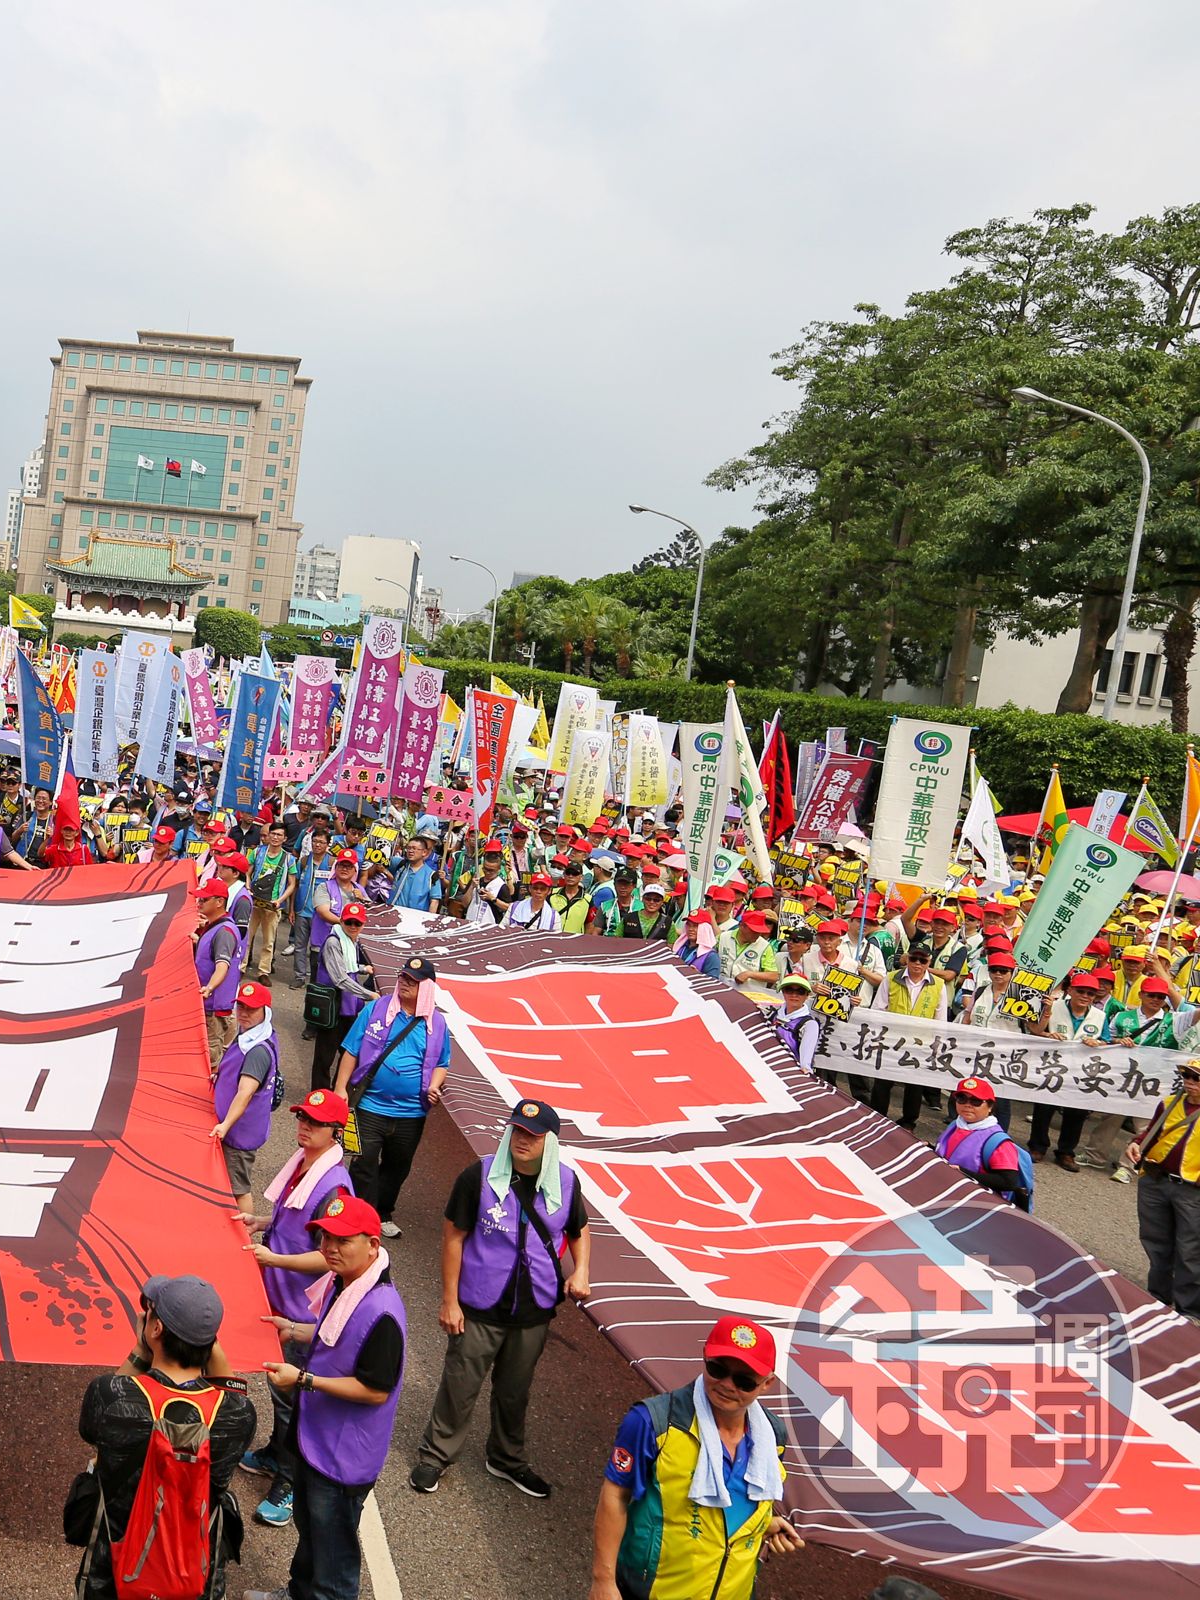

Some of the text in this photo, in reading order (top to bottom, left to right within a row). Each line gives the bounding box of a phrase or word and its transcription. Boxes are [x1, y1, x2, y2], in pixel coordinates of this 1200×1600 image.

[236, 713, 258, 806] 電資工會
[692, 763, 718, 773] CPW
[909, 762, 950, 776] CPWU
[808, 768, 853, 831] 勞權公投
[689, 774, 716, 872] 中華郵政工會
[900, 776, 938, 877] 中華郵政工會
[364, 847, 389, 867] 10%
[1074, 864, 1105, 883] CPWU
[1037, 878, 1091, 963] 中華郵政工會
[814, 996, 847, 1020] 10%
[1002, 997, 1038, 1022] 10%
